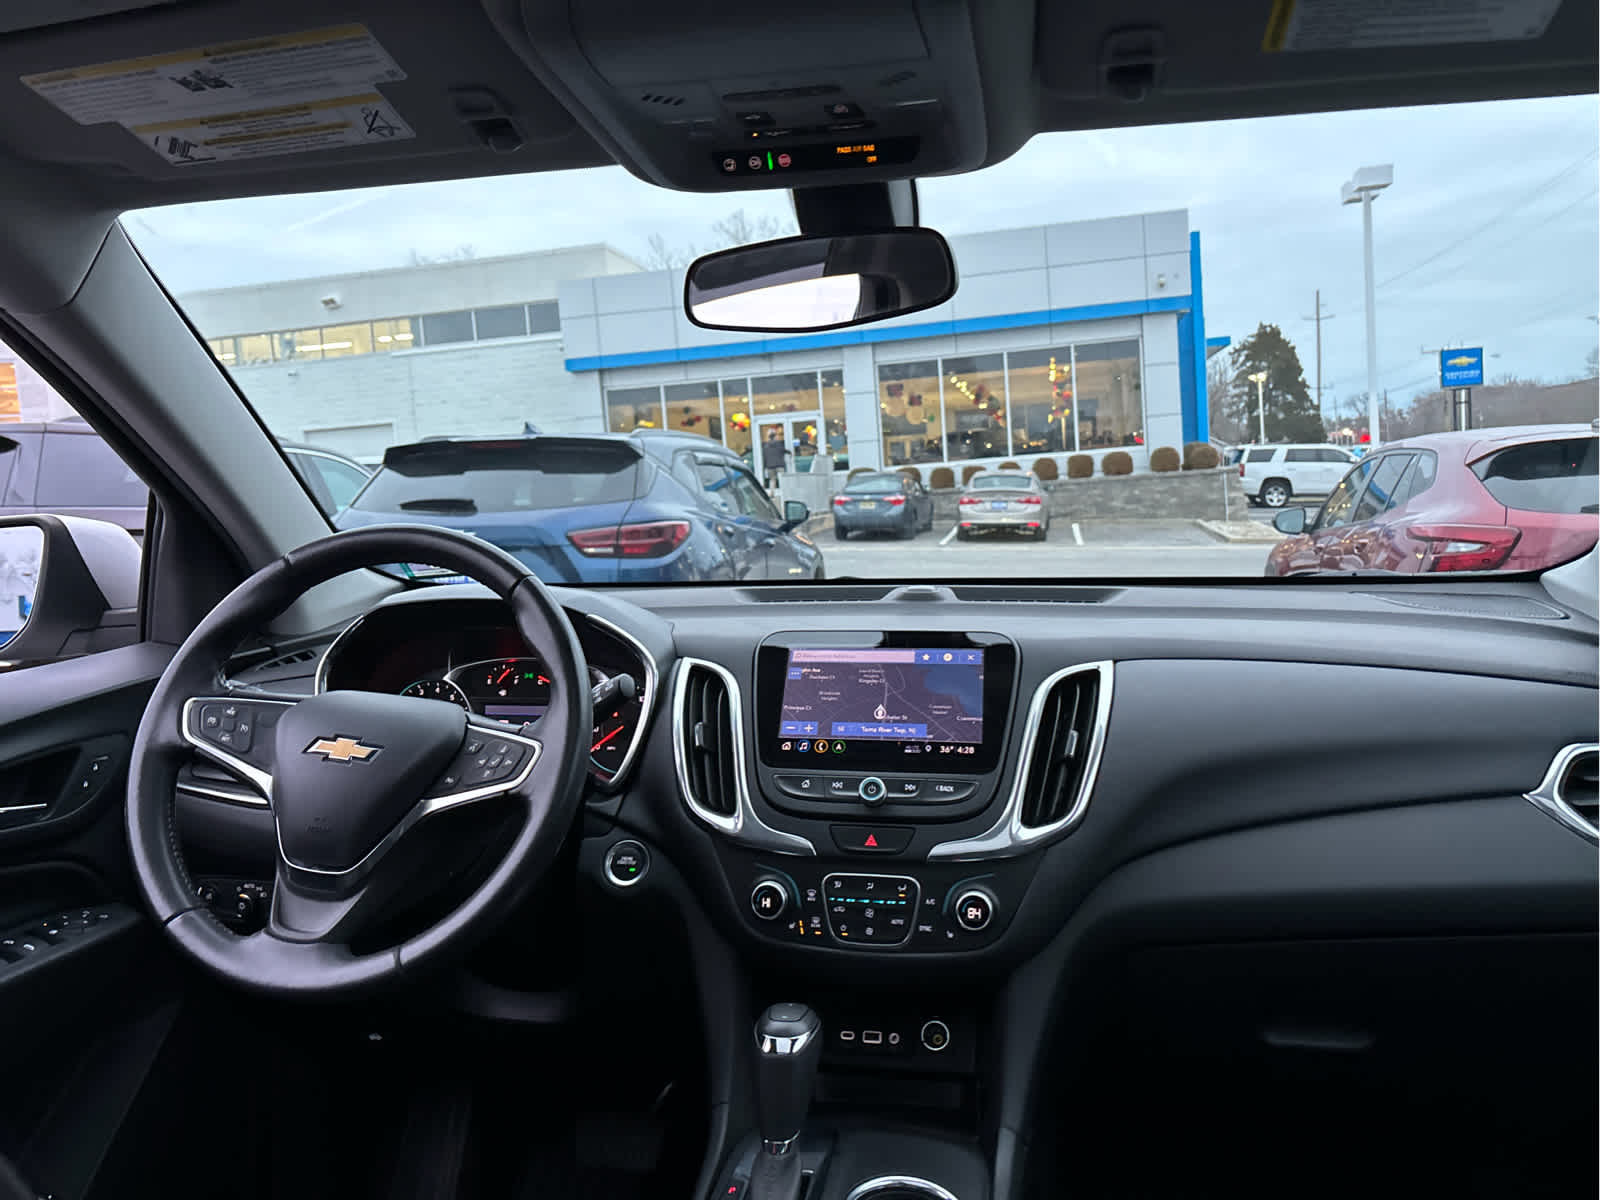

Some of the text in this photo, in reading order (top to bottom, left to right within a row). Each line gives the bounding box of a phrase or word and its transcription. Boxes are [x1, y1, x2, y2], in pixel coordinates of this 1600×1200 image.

[863, 144, 875, 152] BAG
[957, 746, 975, 755] 4:28
[967, 906, 982, 920] 84
